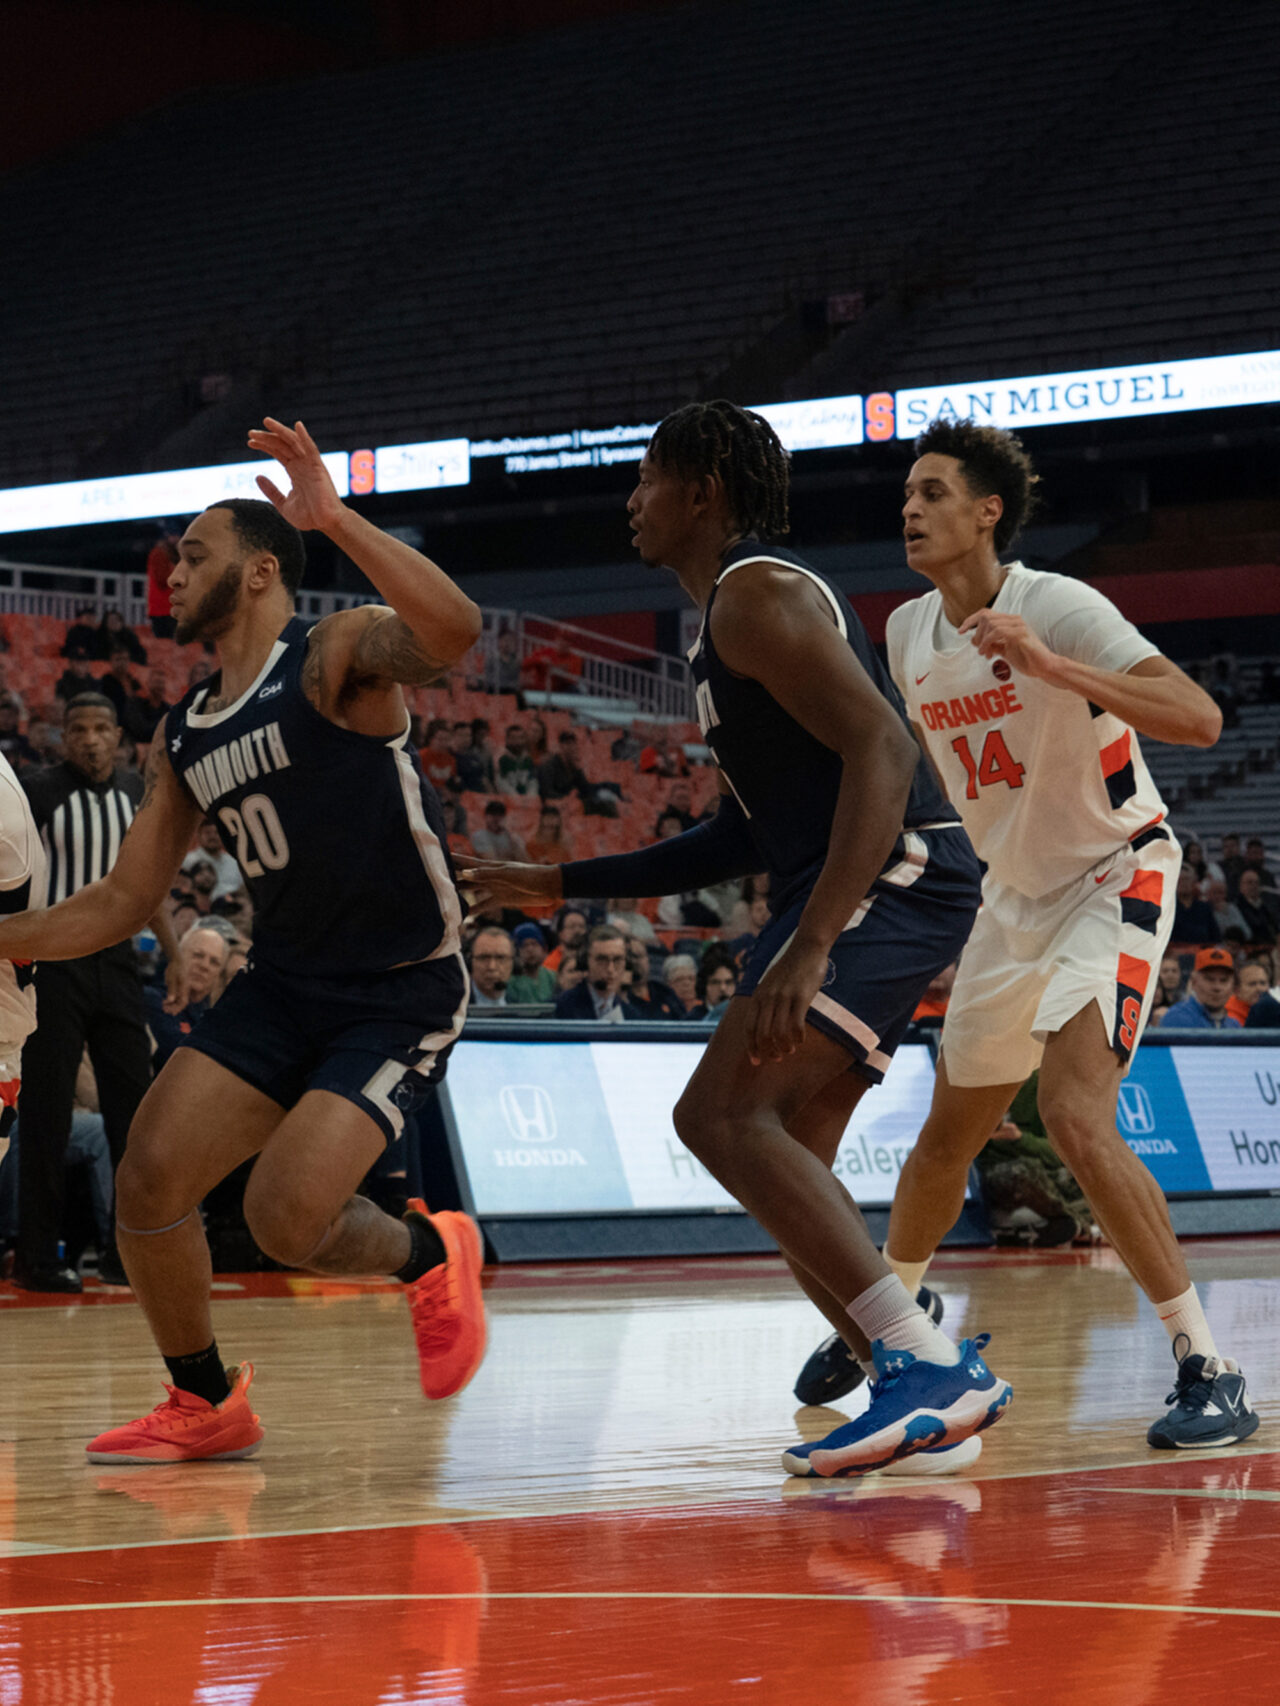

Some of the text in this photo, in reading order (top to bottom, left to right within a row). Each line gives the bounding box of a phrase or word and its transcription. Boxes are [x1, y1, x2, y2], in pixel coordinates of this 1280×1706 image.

[907, 391, 996, 425] SAN
[1008, 373, 1185, 416] MIGUEL
[920, 683, 1024, 731] ORANGE
[951, 730, 1026, 800] 14
[218, 792, 291, 879] 20
[493, 1148, 589, 1167] HONDA
[1125, 1138, 1179, 1156] ONDA
